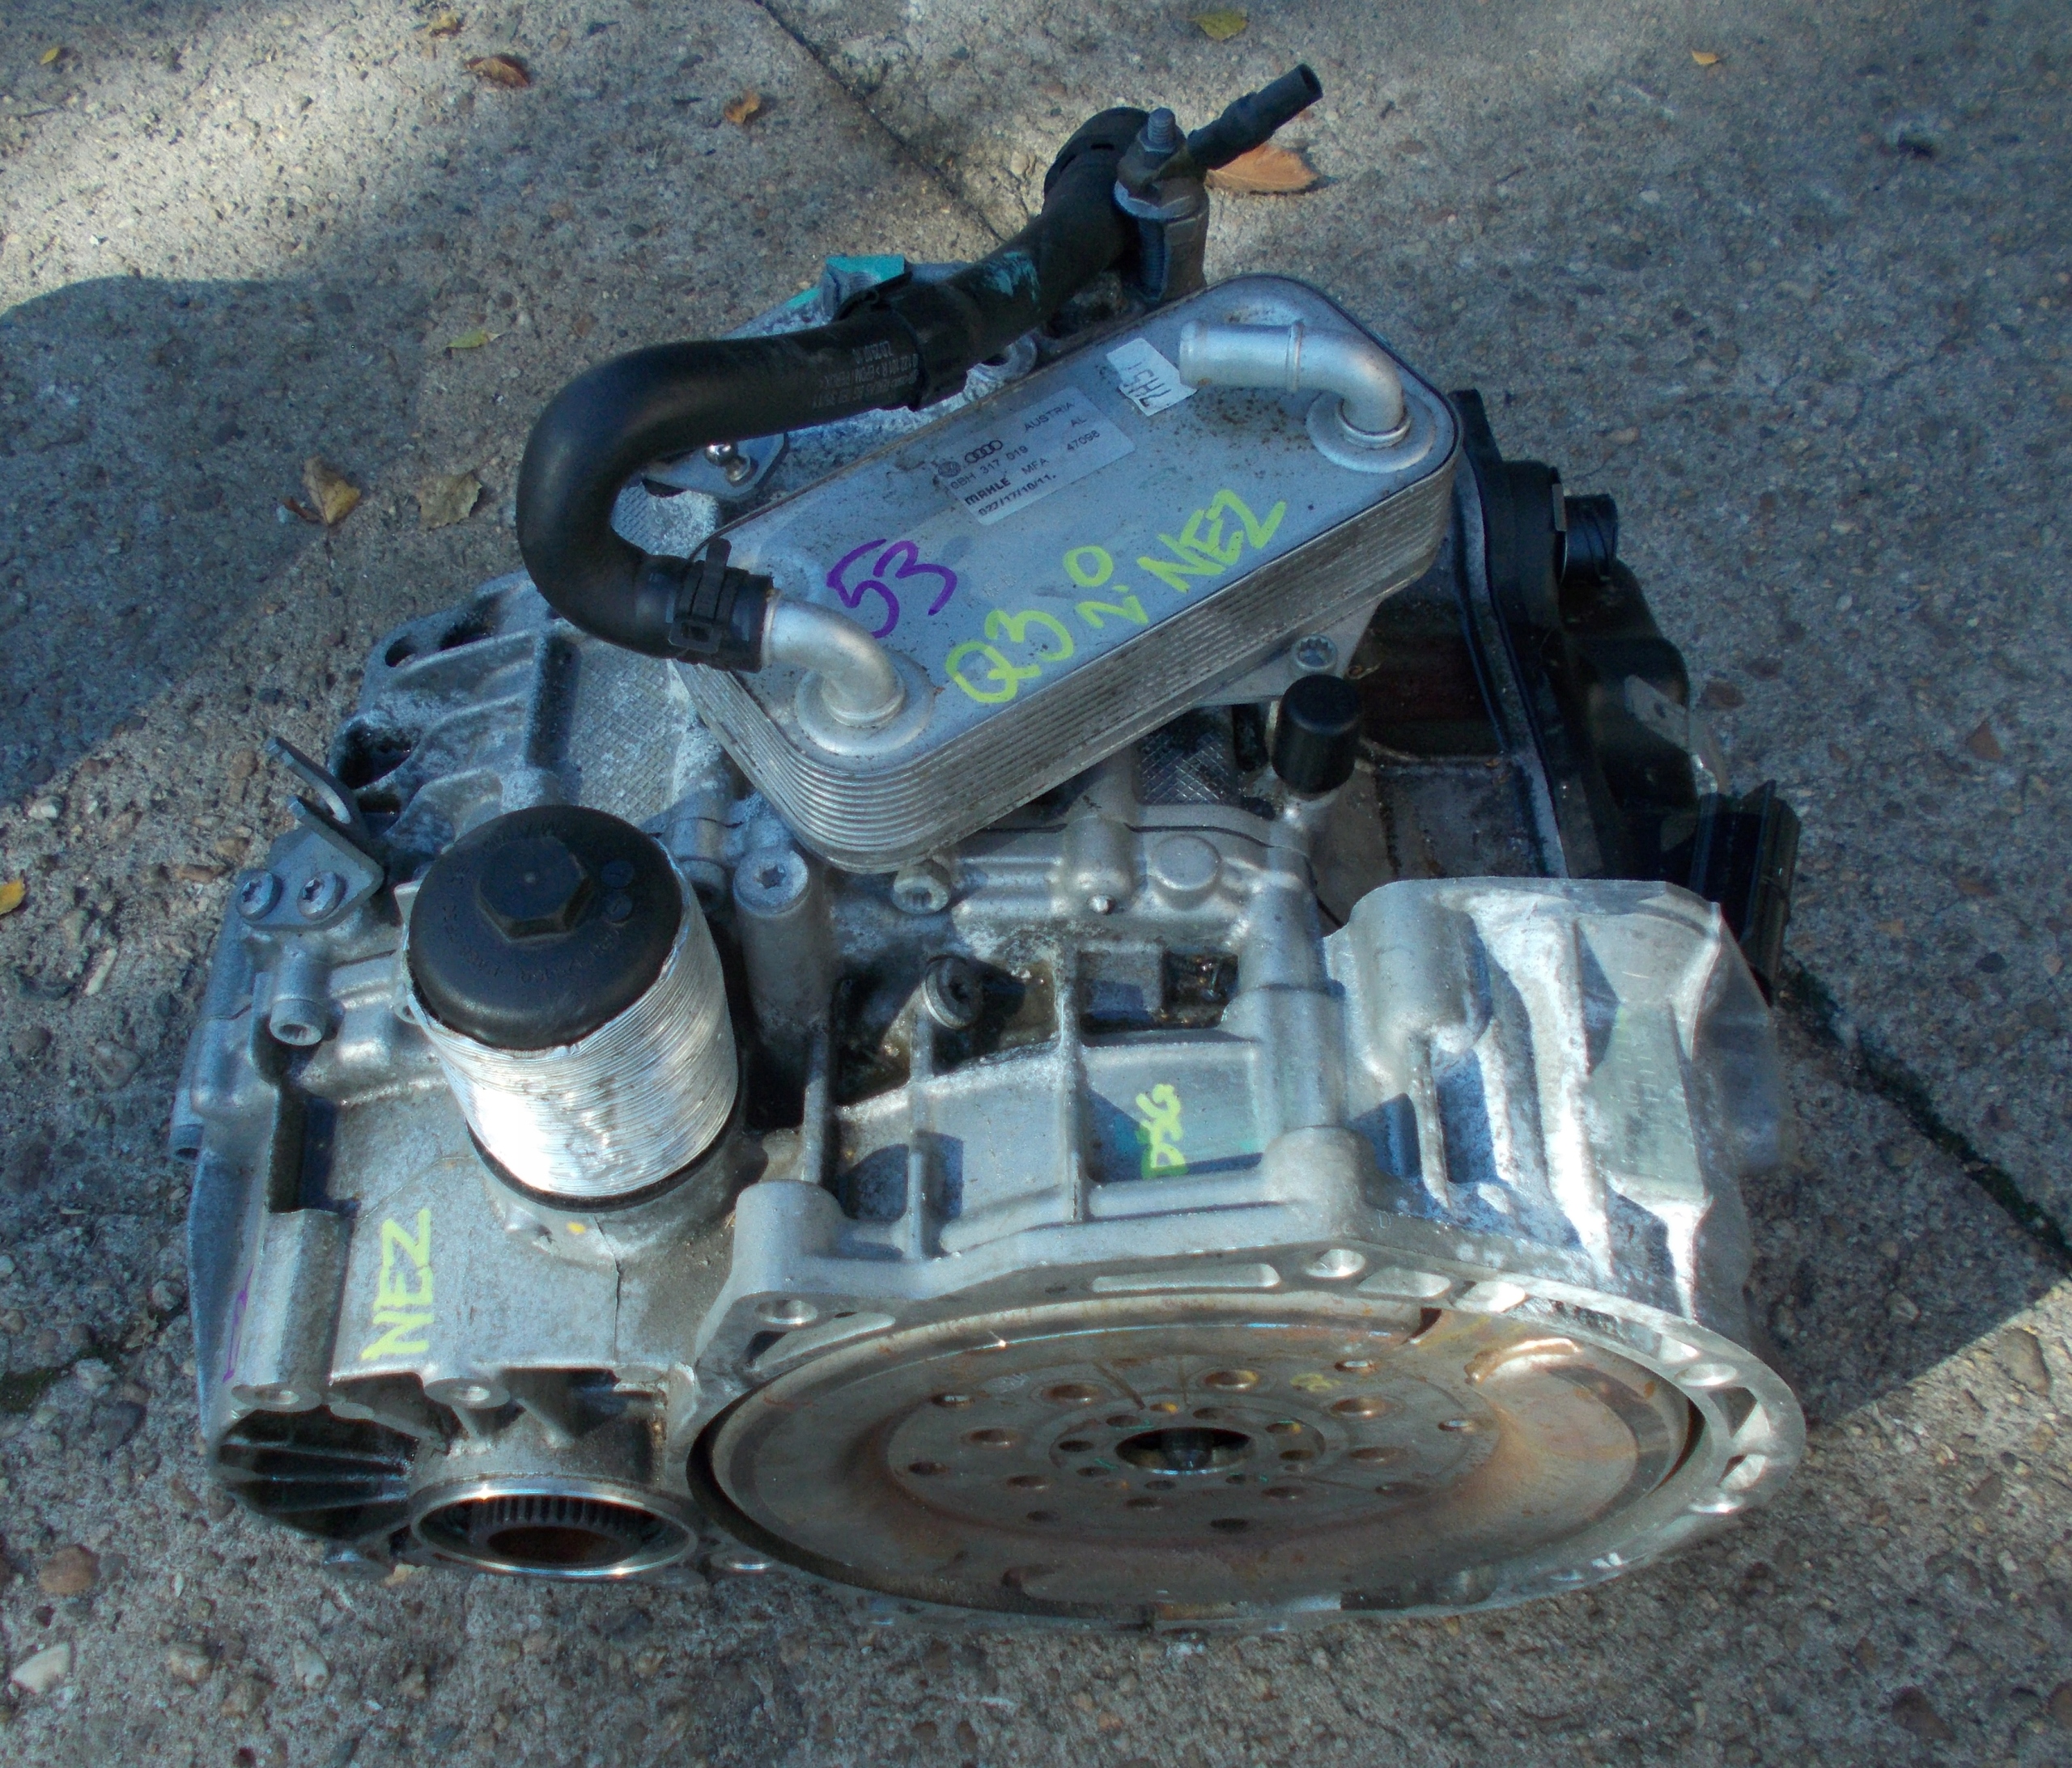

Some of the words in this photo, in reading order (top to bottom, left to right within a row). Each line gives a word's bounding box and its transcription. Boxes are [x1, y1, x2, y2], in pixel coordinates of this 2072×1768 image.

[980, 459, 1000, 474] 317
[1070, 416, 1087, 428] AL
[1024, 401, 1074, 433] AUSTRIA
[964, 477, 1011, 506] MAHLE
[1021, 457, 1051, 476] MFA
[826, 538, 958, 639] 53
[945, 608, 1074, 705] Q3
[1137, 489, 1287, 593] NEZ
[359, 1207, 435, 1361] NEZ
